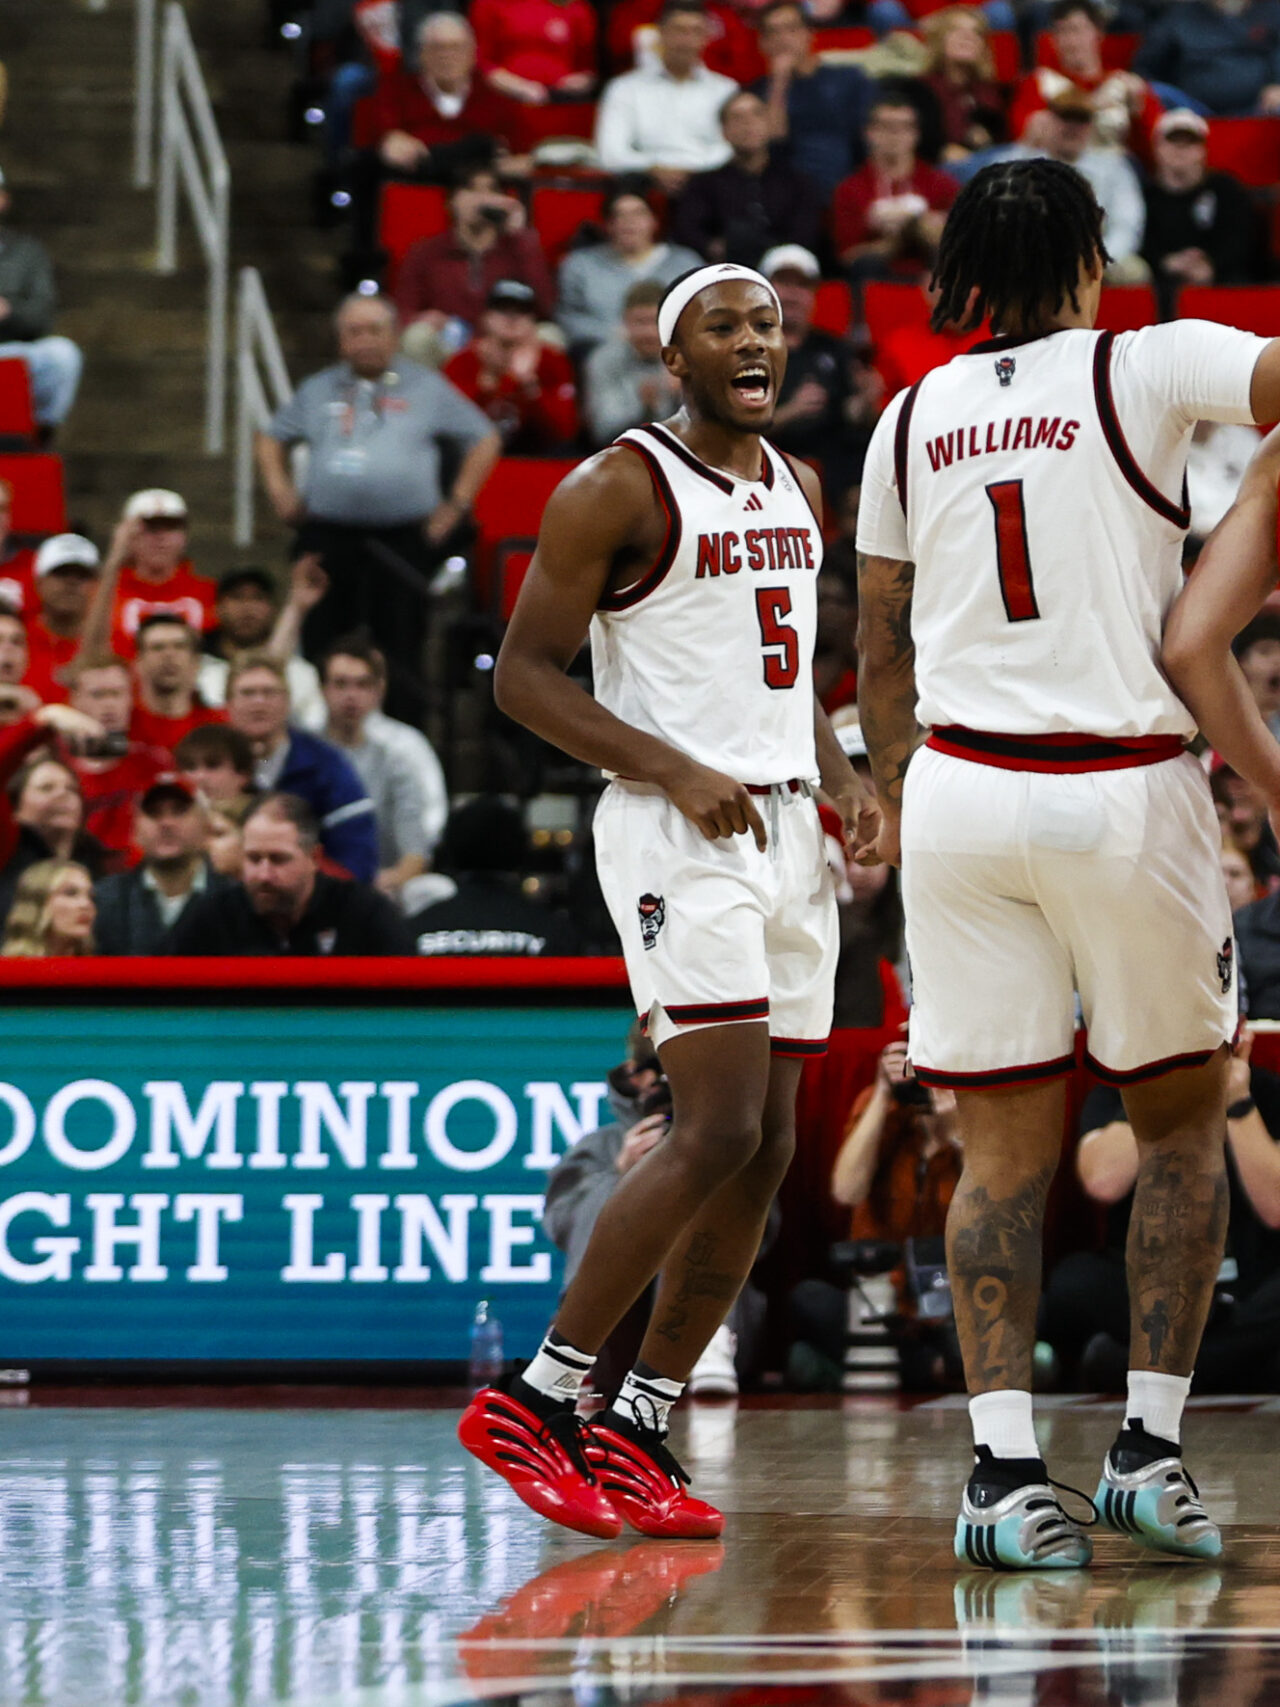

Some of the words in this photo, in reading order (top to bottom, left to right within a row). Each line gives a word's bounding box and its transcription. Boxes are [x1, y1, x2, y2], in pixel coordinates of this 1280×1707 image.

[925, 416, 1080, 472] WILLIAMS
[695, 531, 742, 579] NC
[744, 527, 815, 570] STATE
[984, 478, 1040, 623] 1
[755, 586, 799, 690] 5
[418, 930, 546, 955] SECURITY
[280, 1193, 551, 1283] LINE
